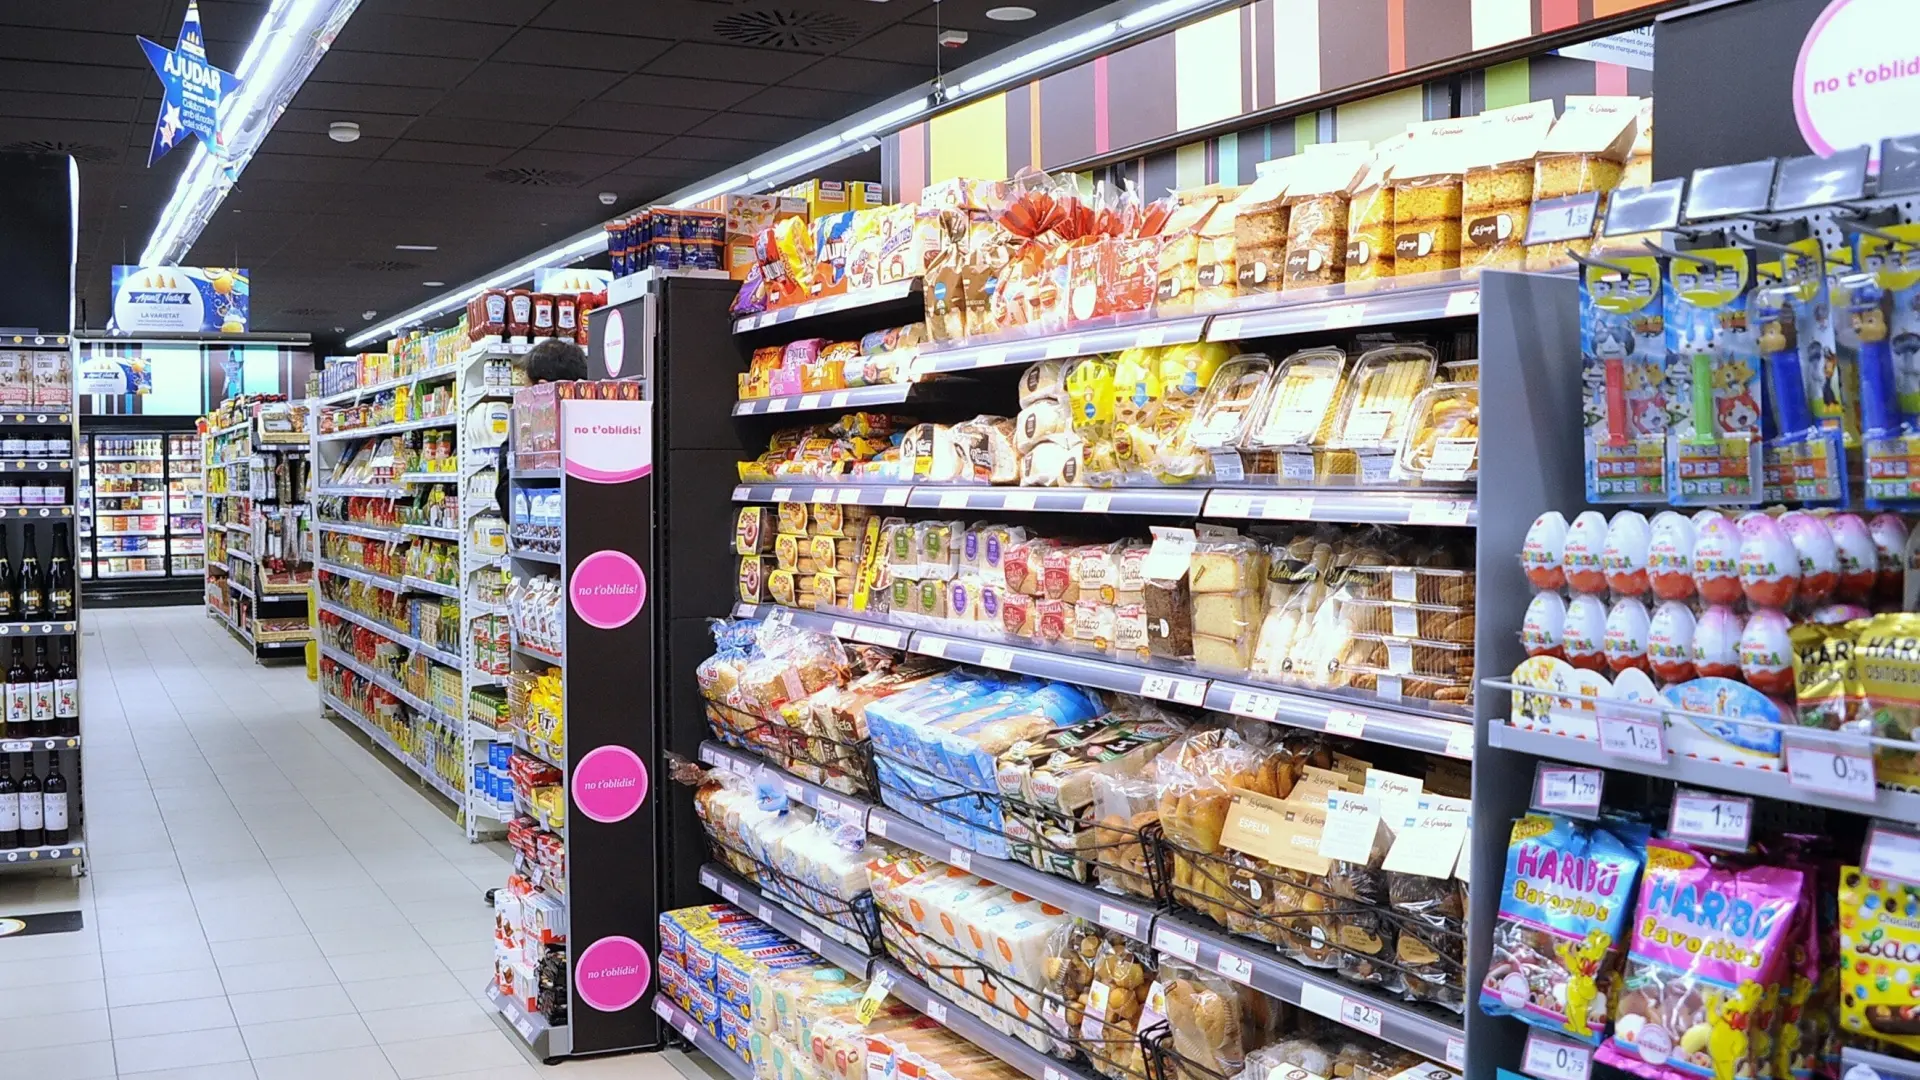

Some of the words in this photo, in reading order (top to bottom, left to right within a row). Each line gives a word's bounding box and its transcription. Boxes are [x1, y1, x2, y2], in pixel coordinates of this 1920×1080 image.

[1616, 46, 1638, 54] marques
[164, 52, 222, 92] AJUDAR
[1813, 78, 1839, 94] no
[150, 312, 180, 320] VARIETAT
[574, 427, 589, 435] no
[592, 425, 642, 435] t'oblidis!
[1599, 461, 1637, 474] PEZ
[1681, 462, 1720, 475] PEZ
[1871, 461, 1908, 475] PEZ
[1599, 481, 1637, 494] PEZ
[1681, 481, 1723, 495] PEZ
[578, 586, 591, 595] no
[592, 584, 638, 595] t'oblidis!
[1627, 725, 1658, 750] 1,25
[584, 780, 597, 790] no
[597, 777, 636, 789] t'oblidis!
[1381, 779, 1389, 789] La
[1388, 780, 1409, 796] Granja
[1567, 773, 1596, 797] 1,70
[1256, 800, 1275, 813] Granja
[1342, 799, 1350, 812] La
[1350, 800, 1369, 815] Granja
[1711, 802, 1743, 828] 1,70
[1239, 816, 1271, 835] ESPELTA
[1420, 817, 1430, 828] La
[1430, 818, 1453, 832] Granja
[1516, 842, 1619, 897] HARIBO
[1641, 915, 1763, 968] favoritos
[752, 945, 797, 959] BIMBO
[587, 970, 600, 980] no
[601, 965, 639, 978] t'oblidis!
